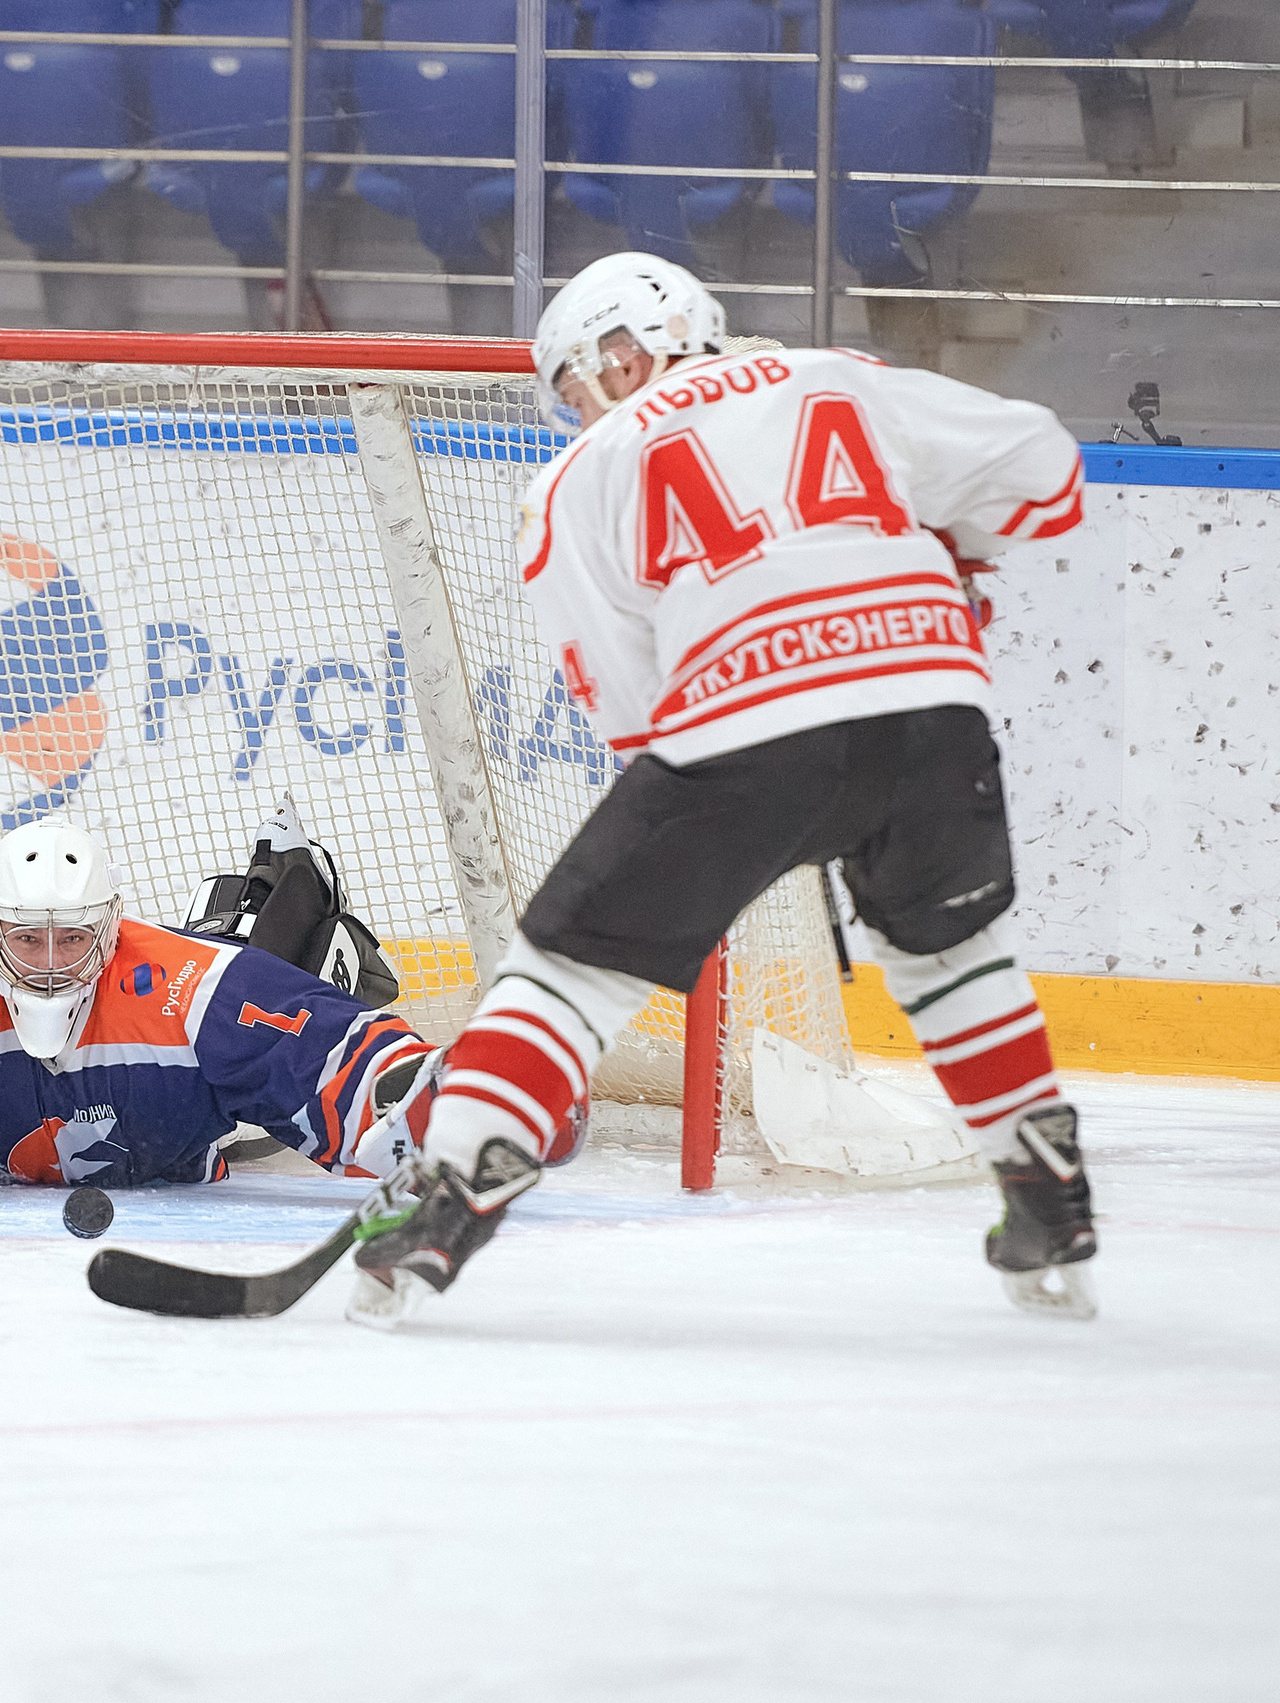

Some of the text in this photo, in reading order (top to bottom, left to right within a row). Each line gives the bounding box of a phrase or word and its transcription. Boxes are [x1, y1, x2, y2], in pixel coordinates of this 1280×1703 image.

[582, 302, 620, 328] CCM
[636, 391, 923, 588] 44
[560, 638, 600, 714] 4
[681, 605, 971, 707] ЯКУТСКЭНЕРГО
[161, 960, 197, 1016] РусГидро
[236, 1000, 313, 1037] 1
